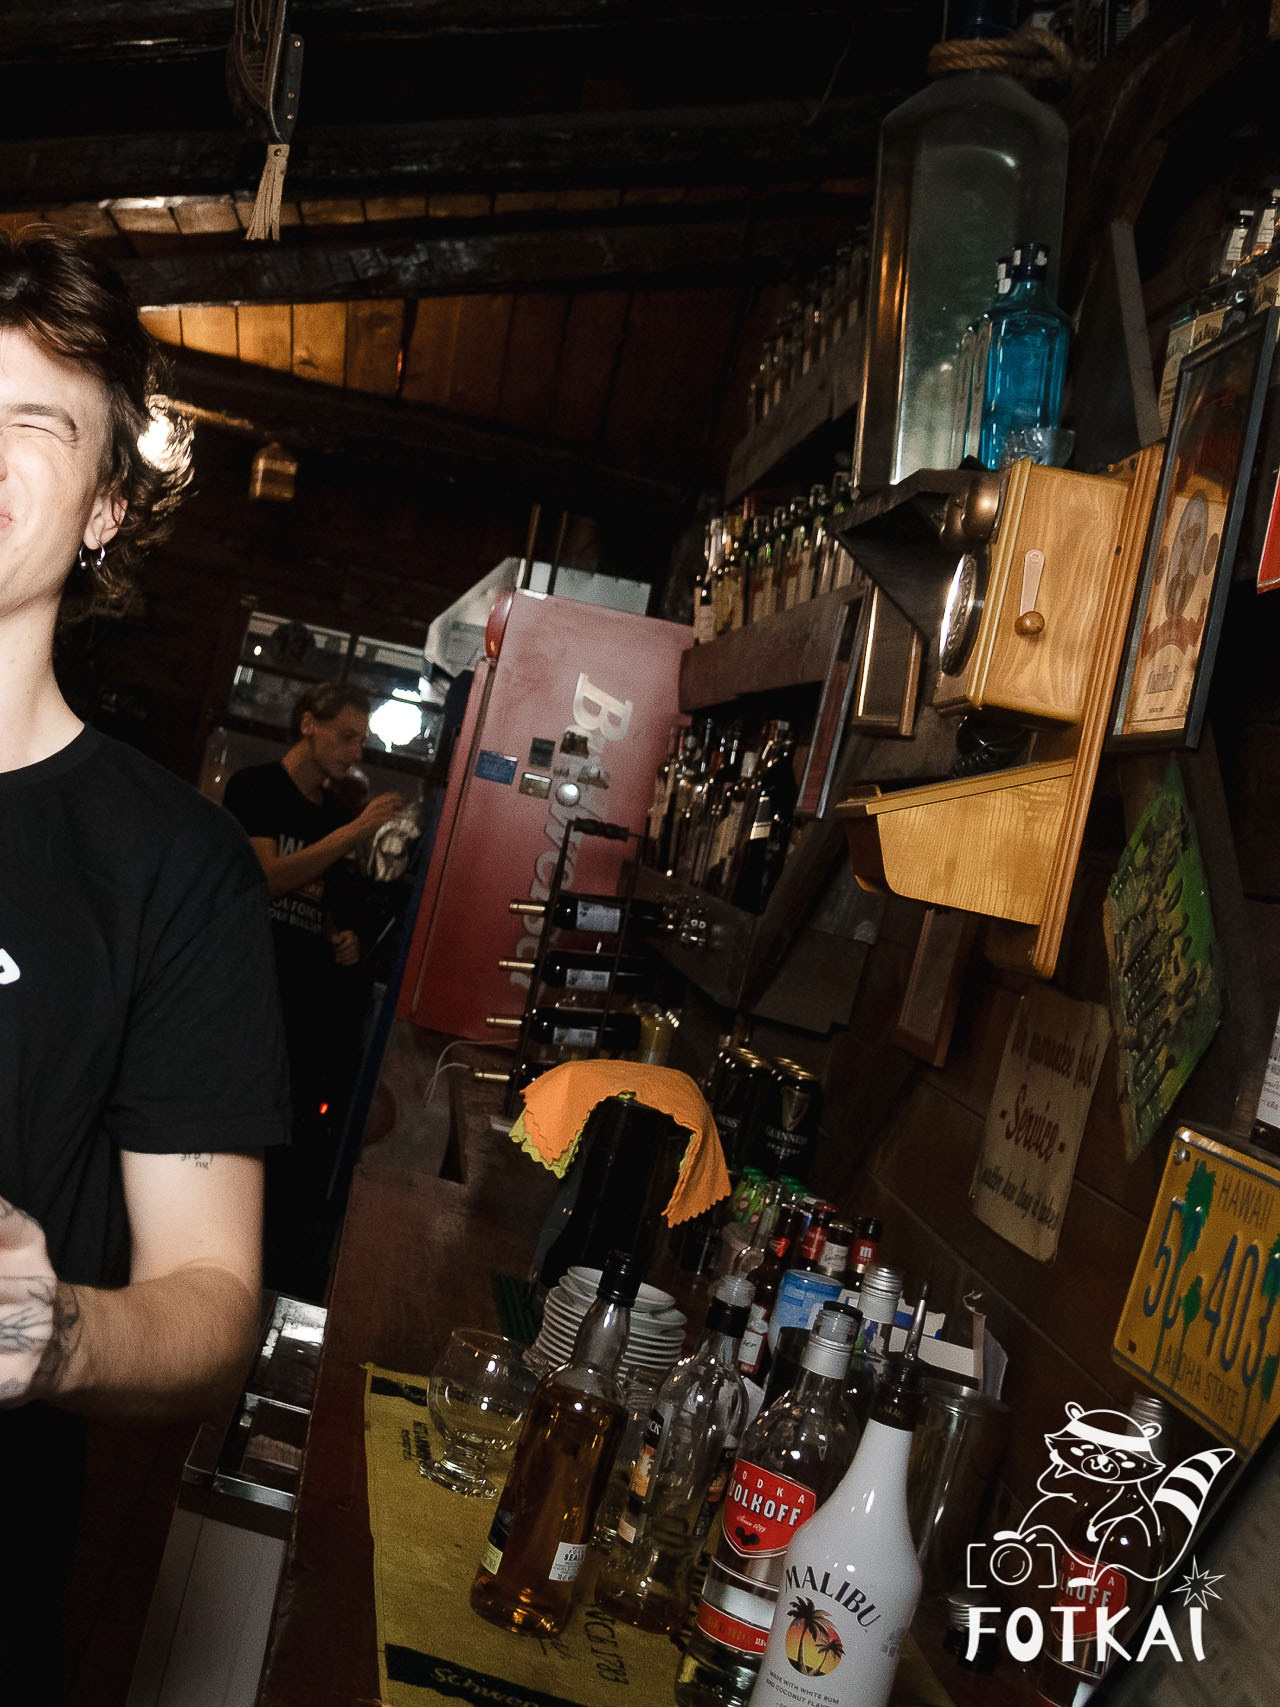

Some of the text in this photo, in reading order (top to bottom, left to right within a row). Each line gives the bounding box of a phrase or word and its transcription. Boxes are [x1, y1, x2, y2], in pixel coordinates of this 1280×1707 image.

[1005, 1084, 1059, 1163] Service
[1217, 1174, 1274, 1231] HAWAII
[1204, 1372, 1239, 1425] STATE
[785, 1565, 881, 1627] MALIBU
[766, 1679, 776, 1688] AND
[775, 1683, 807, 1703] COCONUT
[769, 1670, 839, 1704] MADE WITH WHITE RUM
